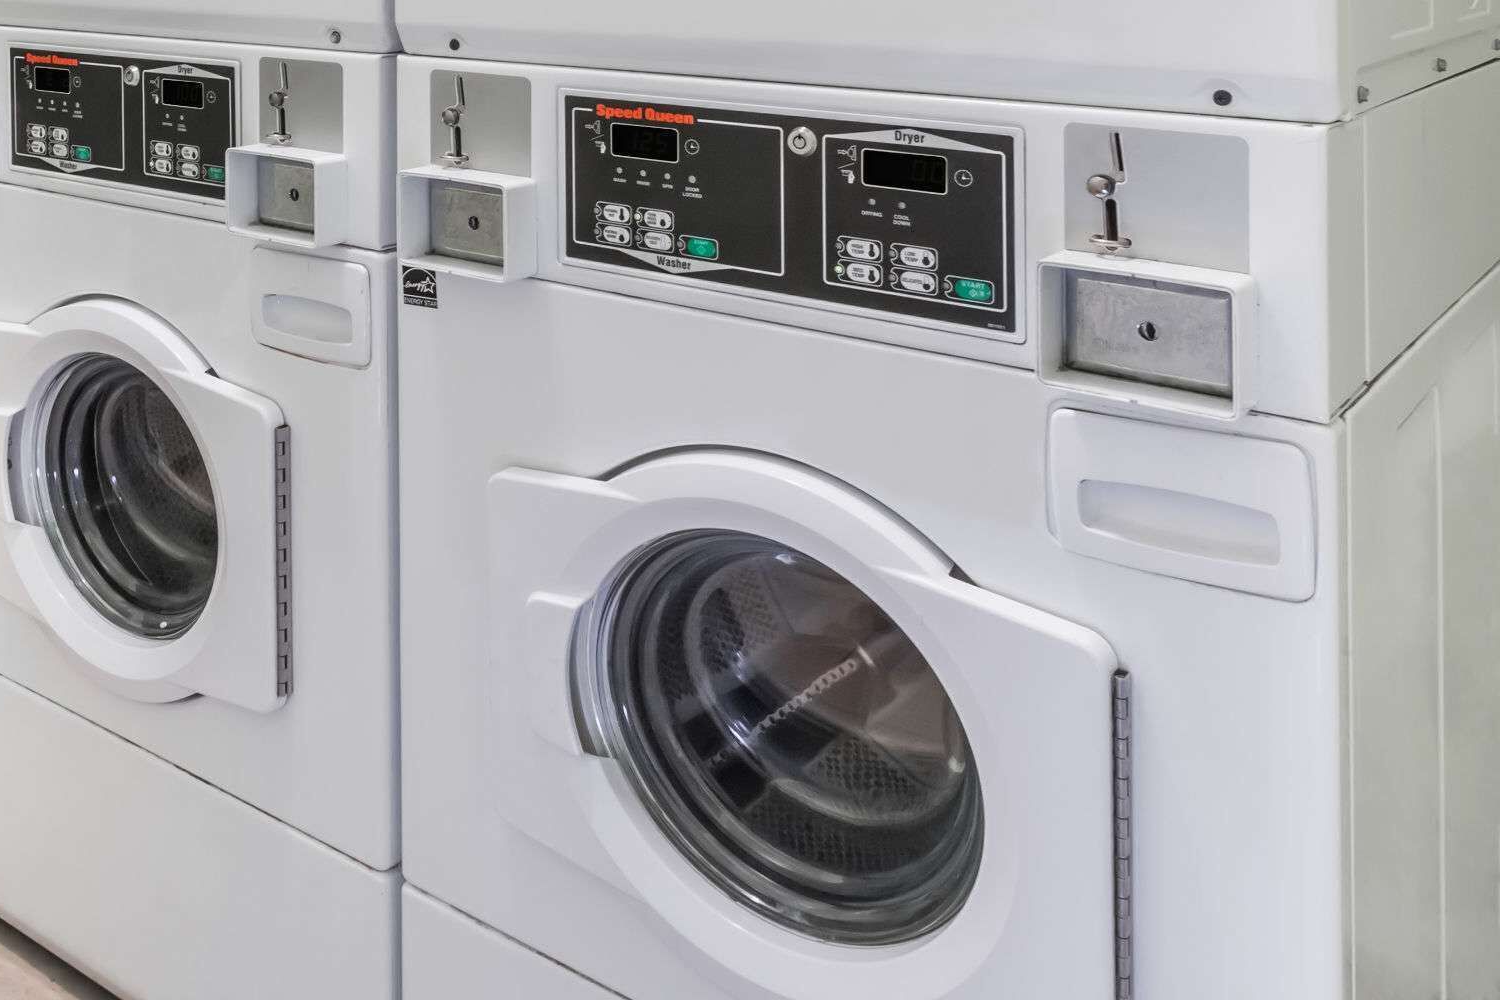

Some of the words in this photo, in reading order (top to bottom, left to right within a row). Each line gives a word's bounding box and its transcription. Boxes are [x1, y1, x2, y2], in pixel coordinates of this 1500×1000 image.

[177, 65, 193, 75] Dryer
[596, 104, 642, 119] Speed
[645, 108, 694, 125] Queen
[894, 131, 925, 144] Dryer
[656, 256, 691, 270] Washer
[960, 281, 986, 289] START
